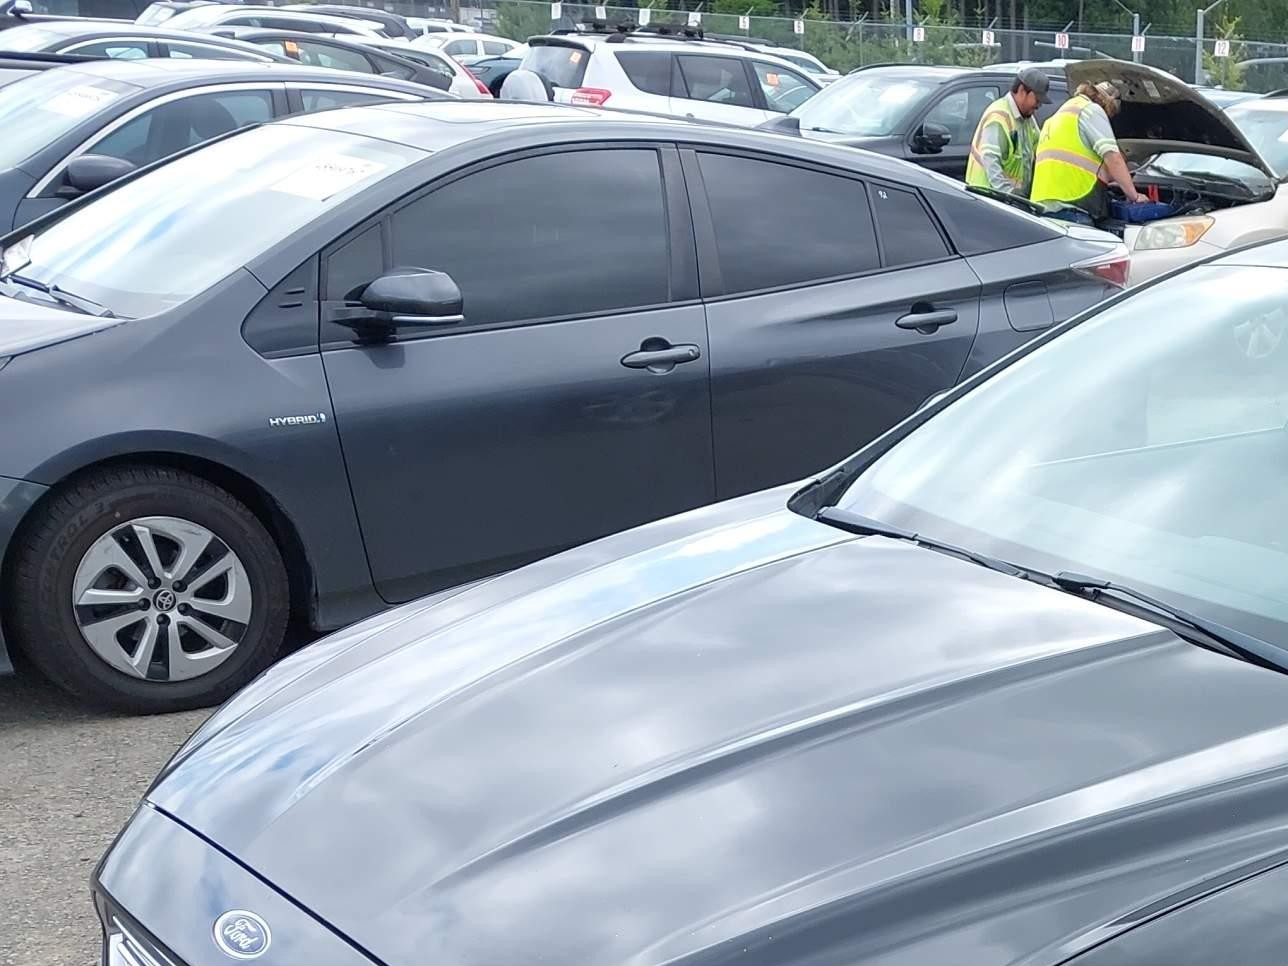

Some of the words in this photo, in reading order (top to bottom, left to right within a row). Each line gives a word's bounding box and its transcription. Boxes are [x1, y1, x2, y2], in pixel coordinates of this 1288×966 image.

[1057, 34, 1068, 47] 10
[1216, 41, 1228, 55] 12
[269, 414, 318, 427] HYBRID
[223, 918, 259, 950] Ford
